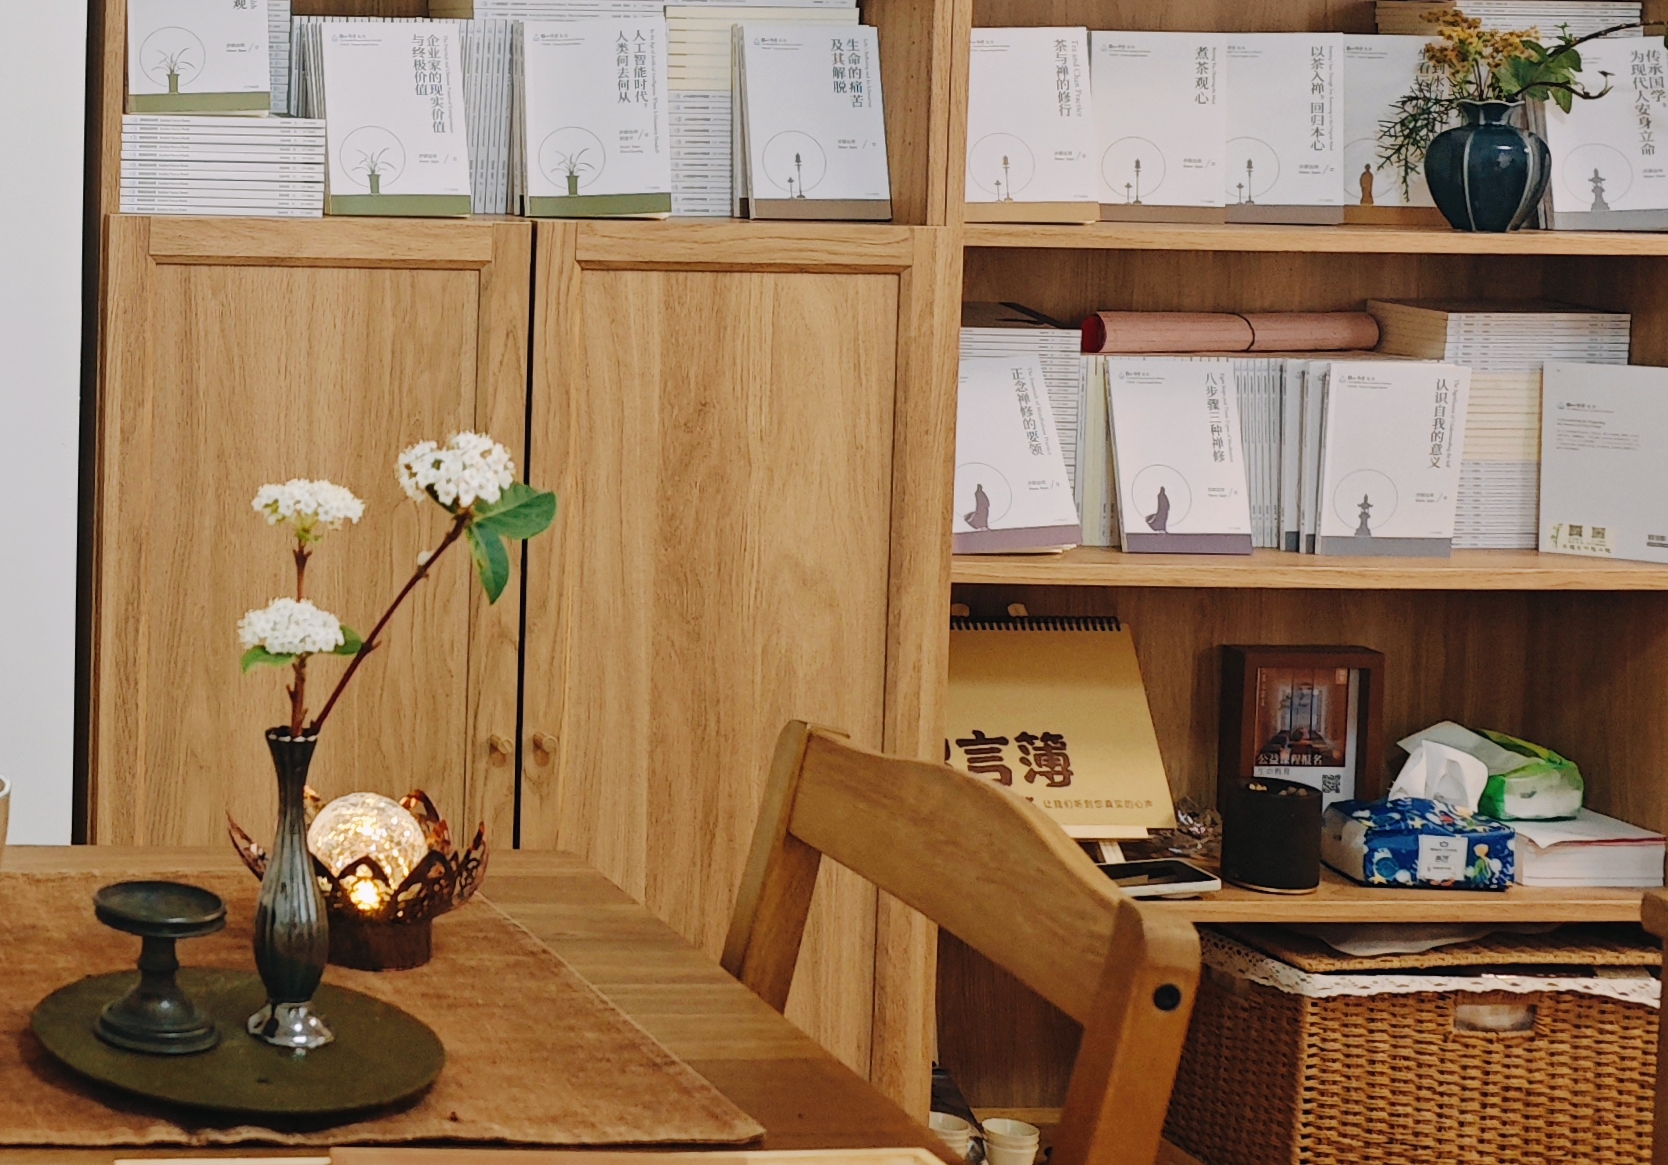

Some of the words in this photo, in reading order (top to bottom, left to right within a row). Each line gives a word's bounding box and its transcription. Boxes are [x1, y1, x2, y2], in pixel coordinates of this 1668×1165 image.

[412, 33, 429, 96] 与终极价值
[427, 34, 446, 133] 企业家的现实价值
[616, 30, 631, 104] 人类何去何从
[831, 38, 847, 94] 及其解脱
[846, 38, 864, 108] 生命的痛苦
[1053, 38, 1072, 117] 茶与禅的修行
[1194, 46, 1209, 105] 煮茶观心
[1310, 45, 1325, 151] 以茶入禅，回归本心
[1631, 50, 1655, 156] 为现代人安身立命
[1011, 367, 1044, 455] 正念禅修的要领
[1205, 372, 1225, 462] 八步骤三种禅修
[1428, 378, 1449, 469] 认识自我的意义
[945, 730, 1074, 788] 言簿
